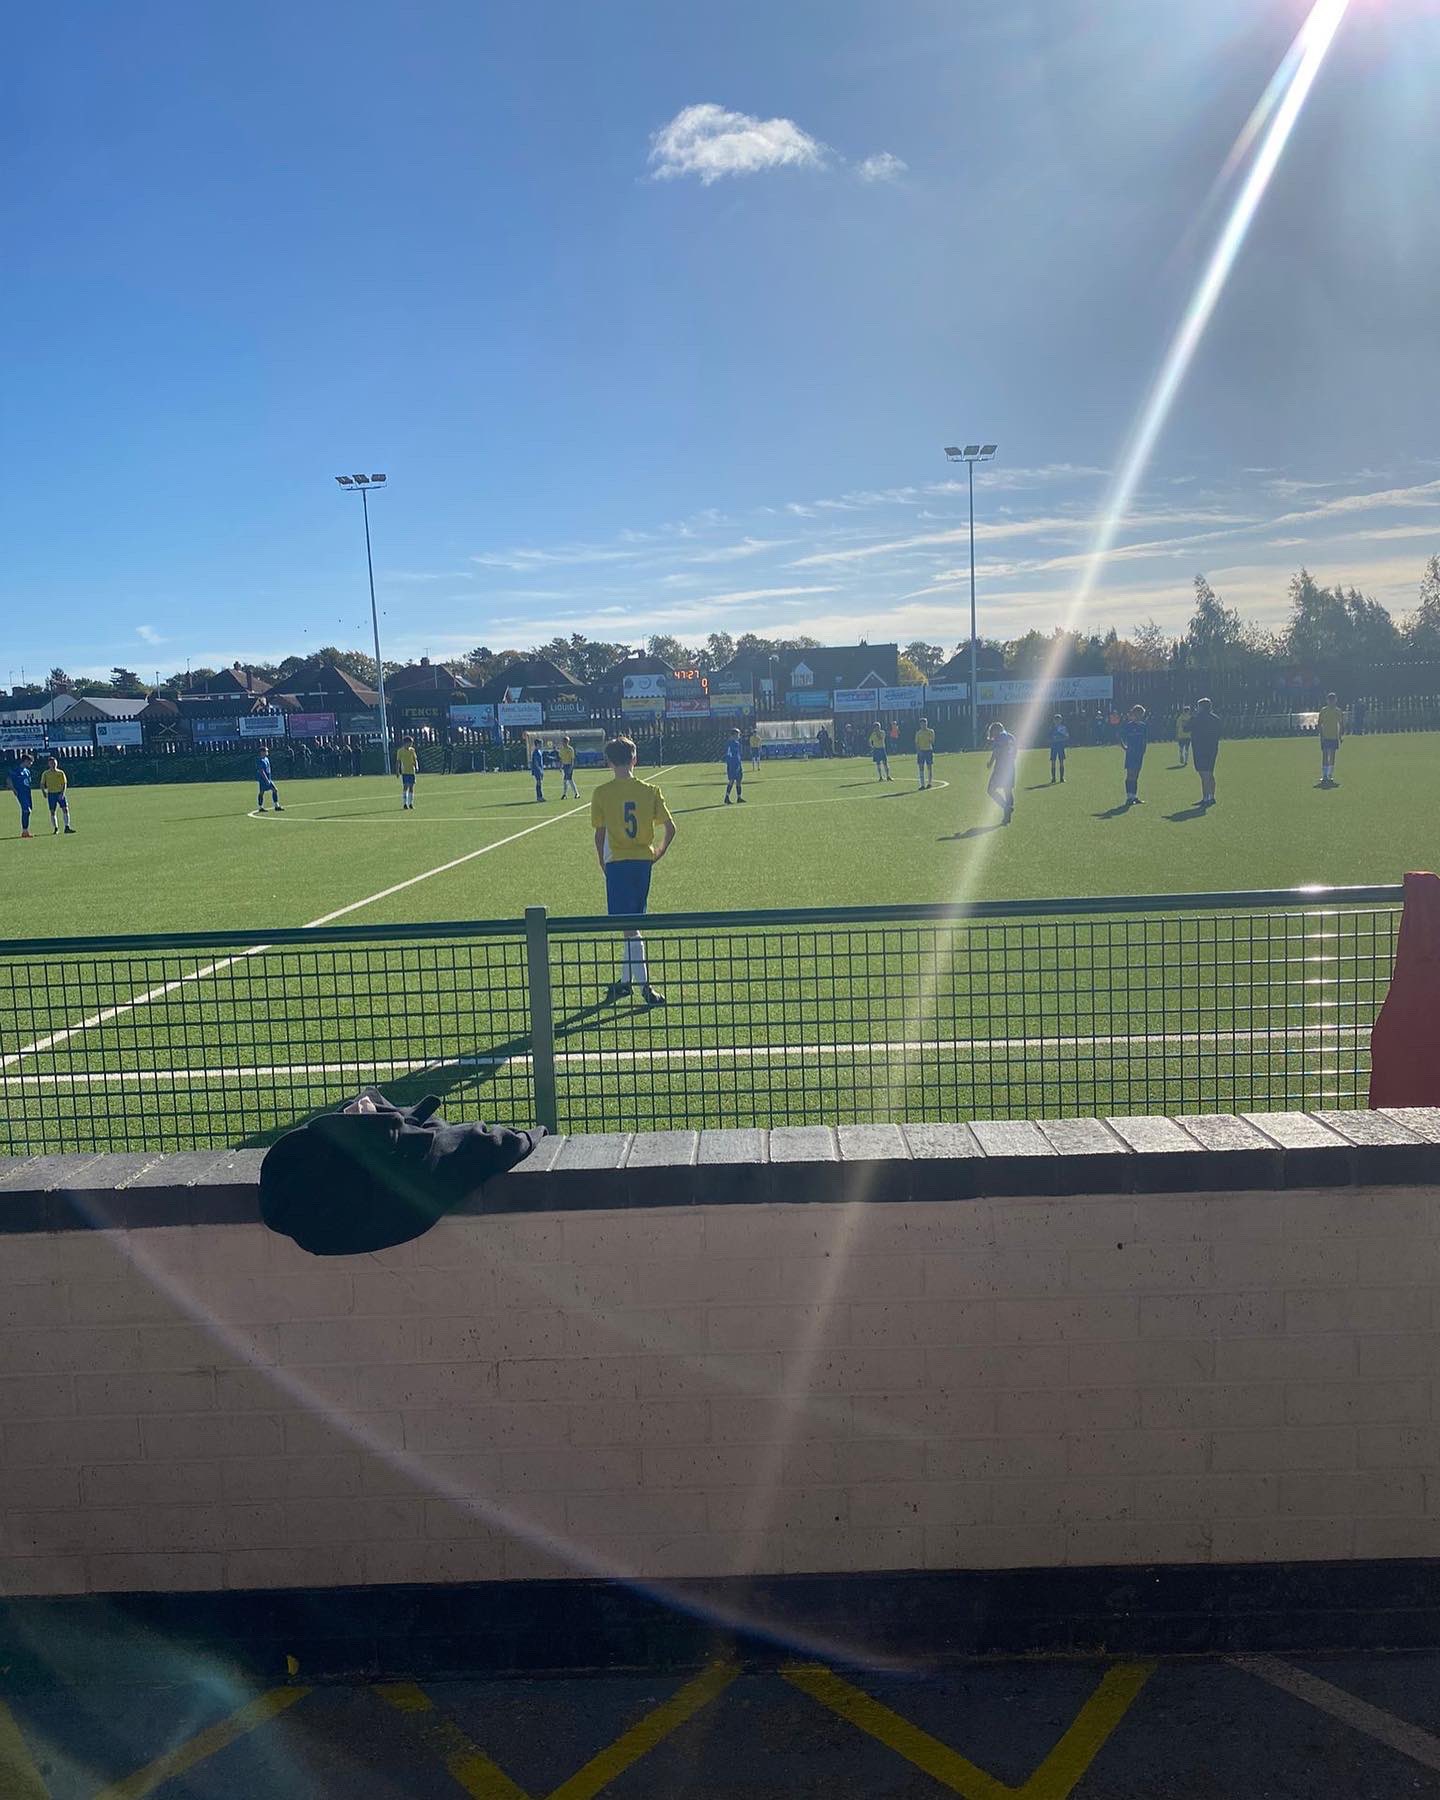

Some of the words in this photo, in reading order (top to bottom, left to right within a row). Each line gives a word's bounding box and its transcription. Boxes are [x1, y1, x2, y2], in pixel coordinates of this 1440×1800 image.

[674, 670, 700, 679] 47:27
[701, 678, 708, 688] 0
[624, 801, 638, 839] 5
